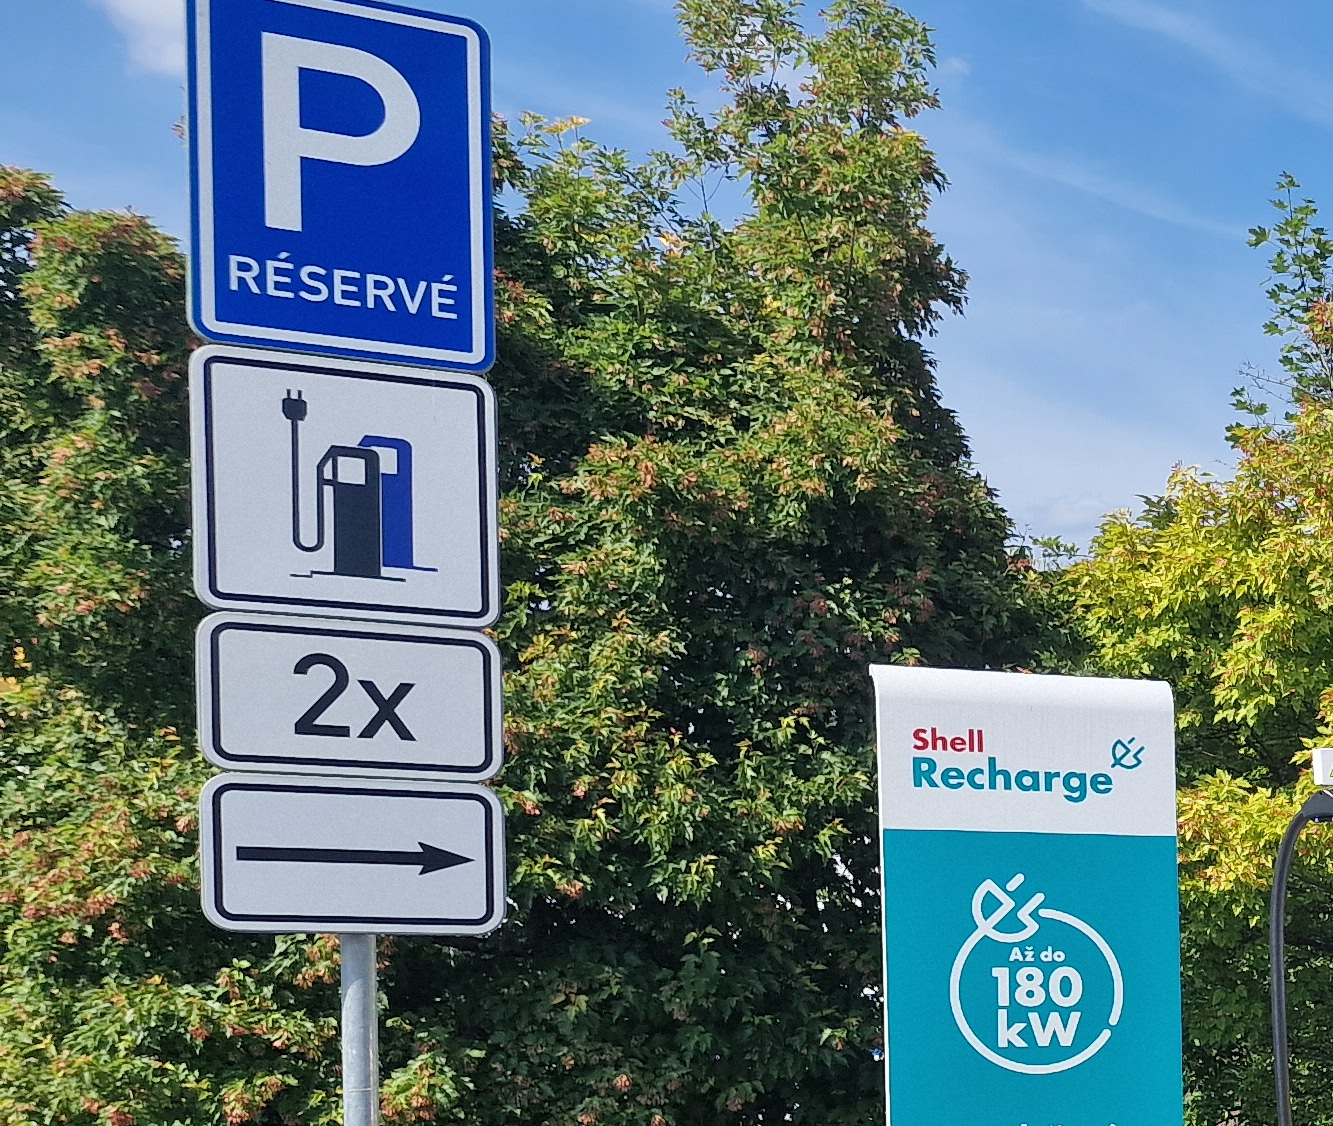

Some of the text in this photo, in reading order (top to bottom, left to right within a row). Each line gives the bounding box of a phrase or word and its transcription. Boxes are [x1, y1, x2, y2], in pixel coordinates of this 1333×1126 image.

[261, 31, 421, 232] P
[228, 252, 459, 320] RÉSERVÉ
[293, 652, 417, 742] 2x
[912, 728, 984, 753] Shell
[912, 756, 1113, 803] Recharge
[1008, 946, 1065, 962] Až do
[991, 966, 1083, 1008] 180
[997, 1008, 1081, 1048] kW
